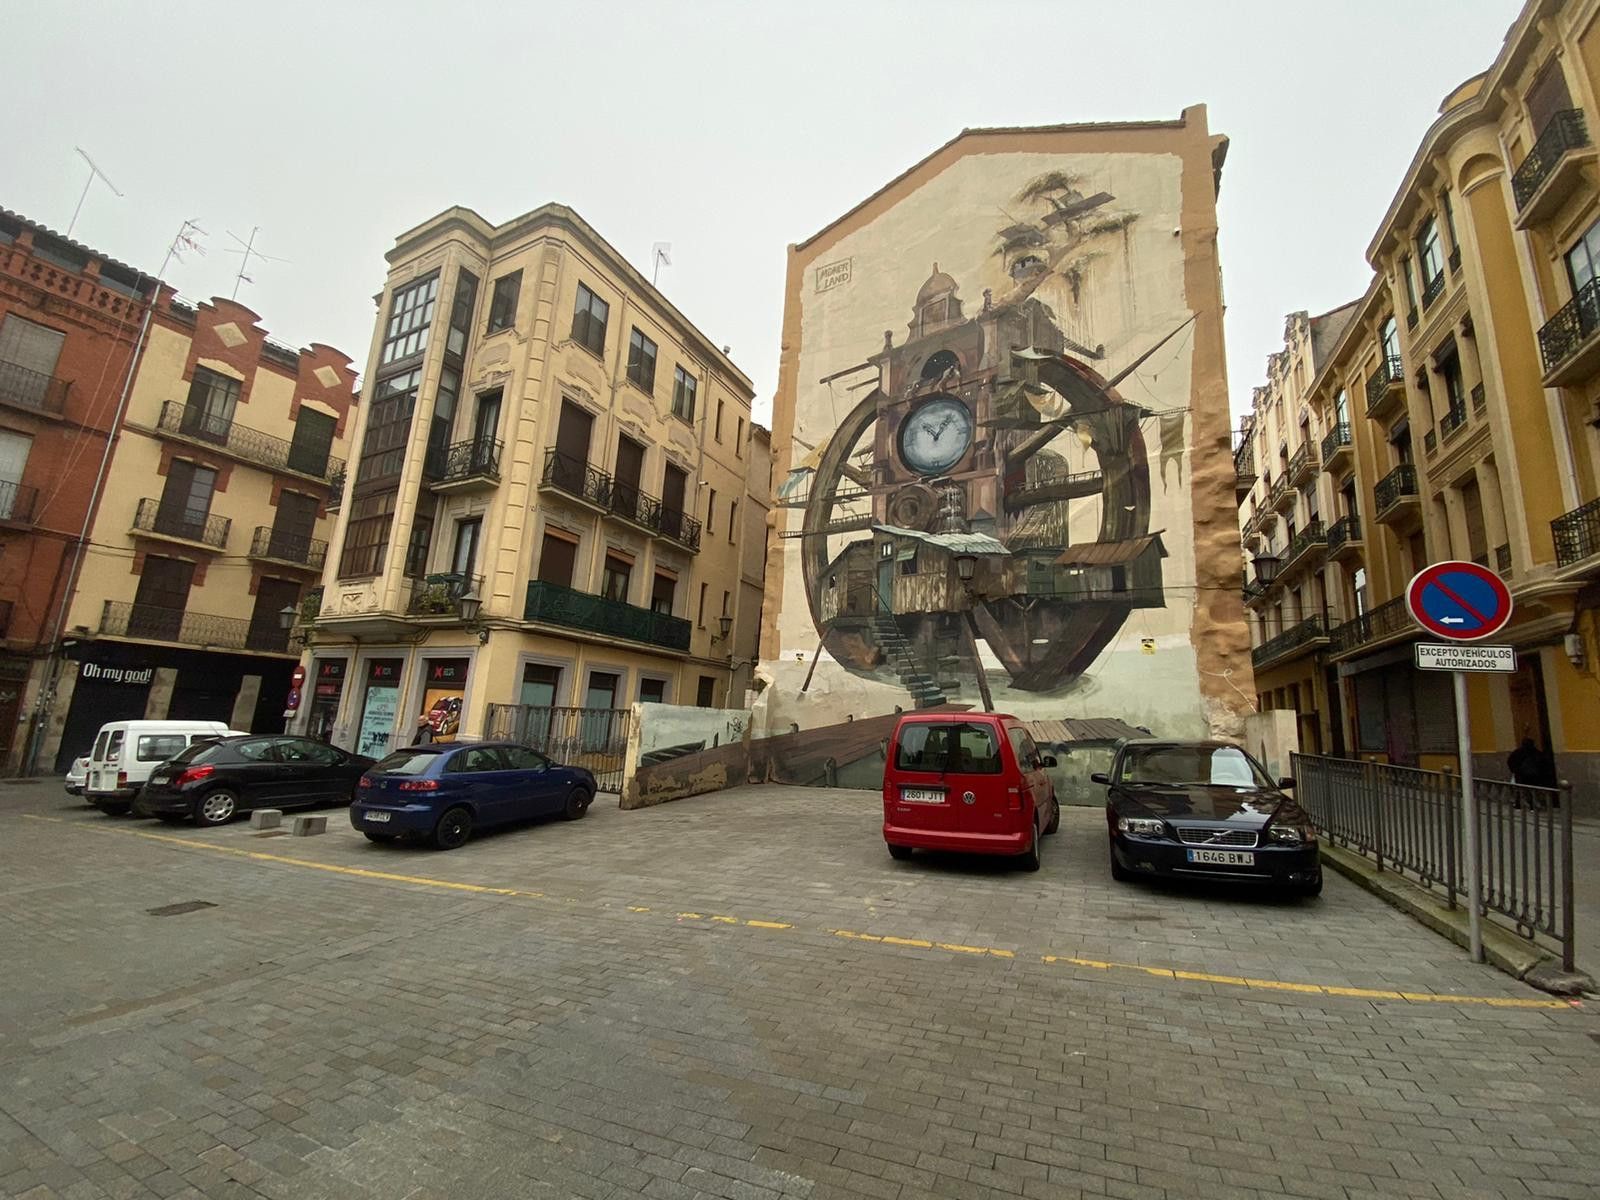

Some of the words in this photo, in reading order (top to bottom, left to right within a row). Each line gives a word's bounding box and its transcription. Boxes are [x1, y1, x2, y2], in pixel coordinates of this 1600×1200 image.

[824, 273, 849, 289] LAND
[1420, 648, 1459, 658] EXCEPTO
[1435, 658, 1497, 668] AUTORIZADOS
[83, 663, 101, 678] Oh
[102, 669, 123, 682] my
[124, 669, 152, 684] god!
[1196, 851, 1225, 862] 1646
[1229, 853, 1252, 864] BWJ
